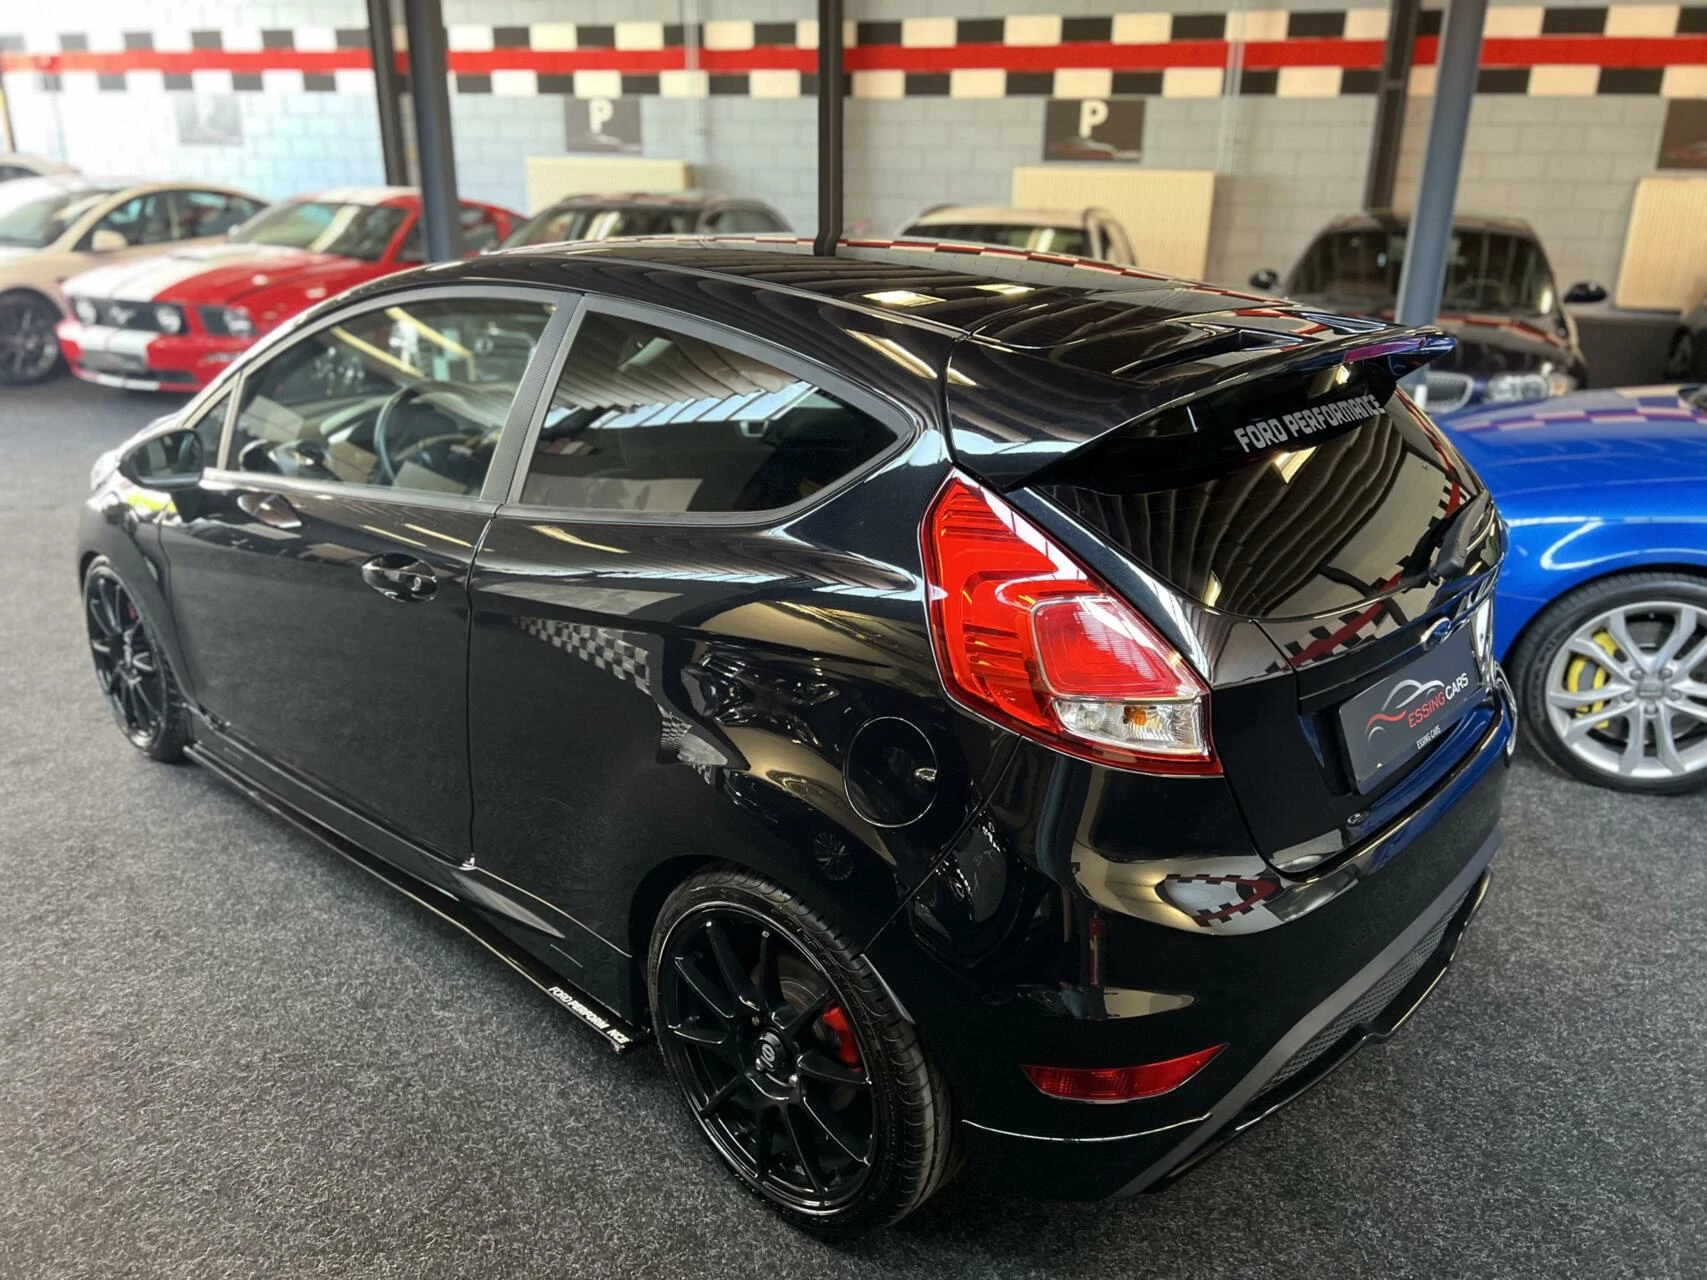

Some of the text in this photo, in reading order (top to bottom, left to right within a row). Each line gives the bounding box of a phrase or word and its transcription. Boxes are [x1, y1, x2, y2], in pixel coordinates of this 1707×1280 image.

[589, 99, 614, 133] P
[1079, 99, 1109, 138] P
[1234, 394, 1386, 453] FORD PERFORMANCE
[1407, 672, 1469, 728] ESSING CARS
[1416, 724, 1442, 749] ESSING CARS
[548, 986, 573, 1003] FORD
